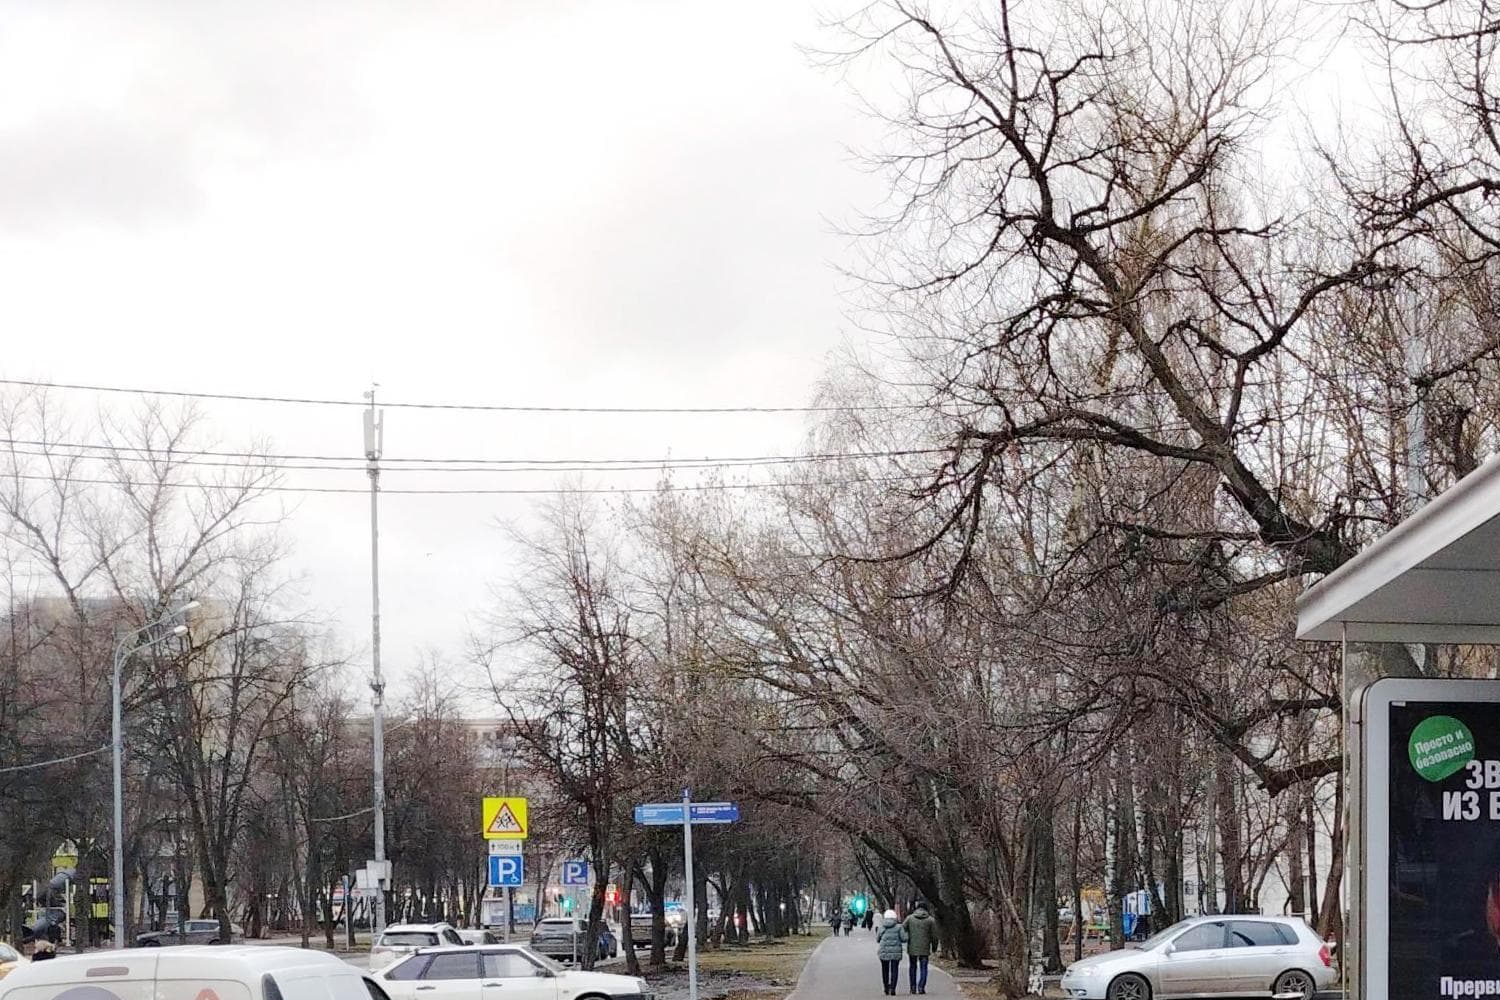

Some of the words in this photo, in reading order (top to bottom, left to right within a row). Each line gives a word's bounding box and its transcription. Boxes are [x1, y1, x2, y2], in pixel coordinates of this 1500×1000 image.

[1414, 733, 1454, 755] Просто
[1455, 729, 1465, 740] и
[1415, 741, 1473, 770] безопасно
[1442, 791, 1481, 821] ИЗ
[498, 858, 516, 883] P
